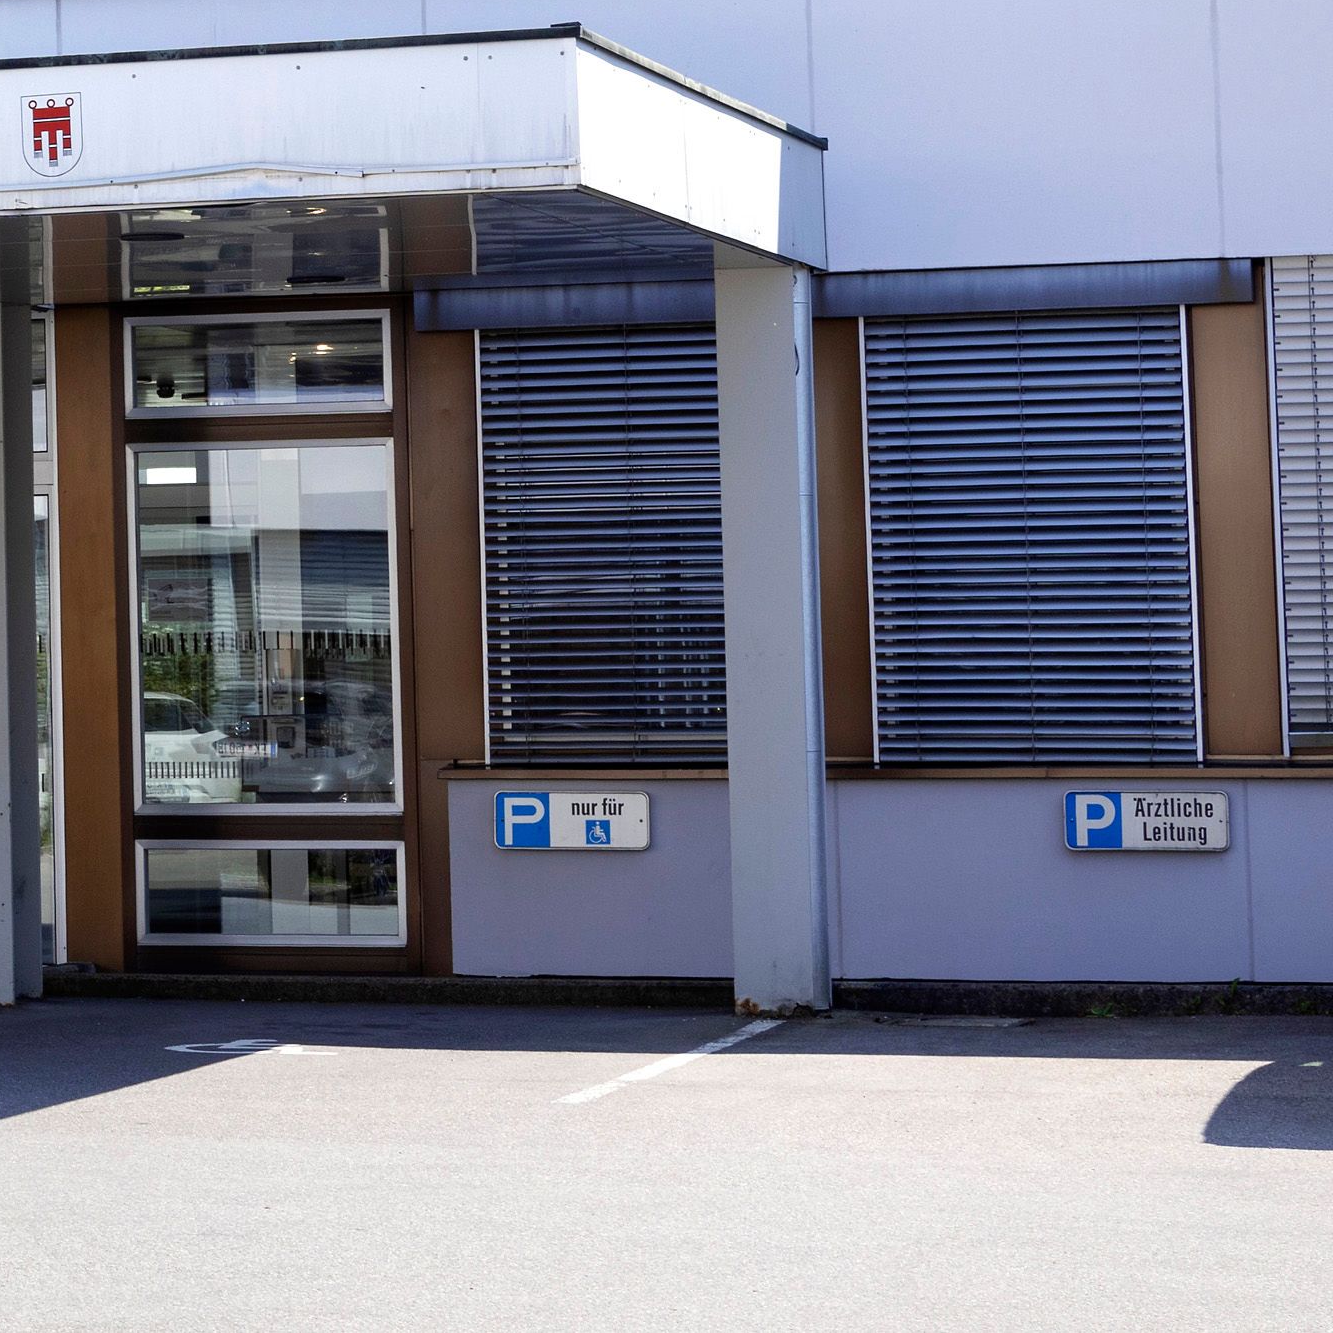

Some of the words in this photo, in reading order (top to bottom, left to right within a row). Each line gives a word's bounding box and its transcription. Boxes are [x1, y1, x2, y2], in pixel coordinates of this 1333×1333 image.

[571, 802, 597, 816] nur
[602, 797, 624, 816] für
[1133, 797, 1214, 818] Ärztliche
[504, 797, 545, 845] P
[1075, 794, 1116, 846] P
[1143, 822, 1208, 846] Leitung
